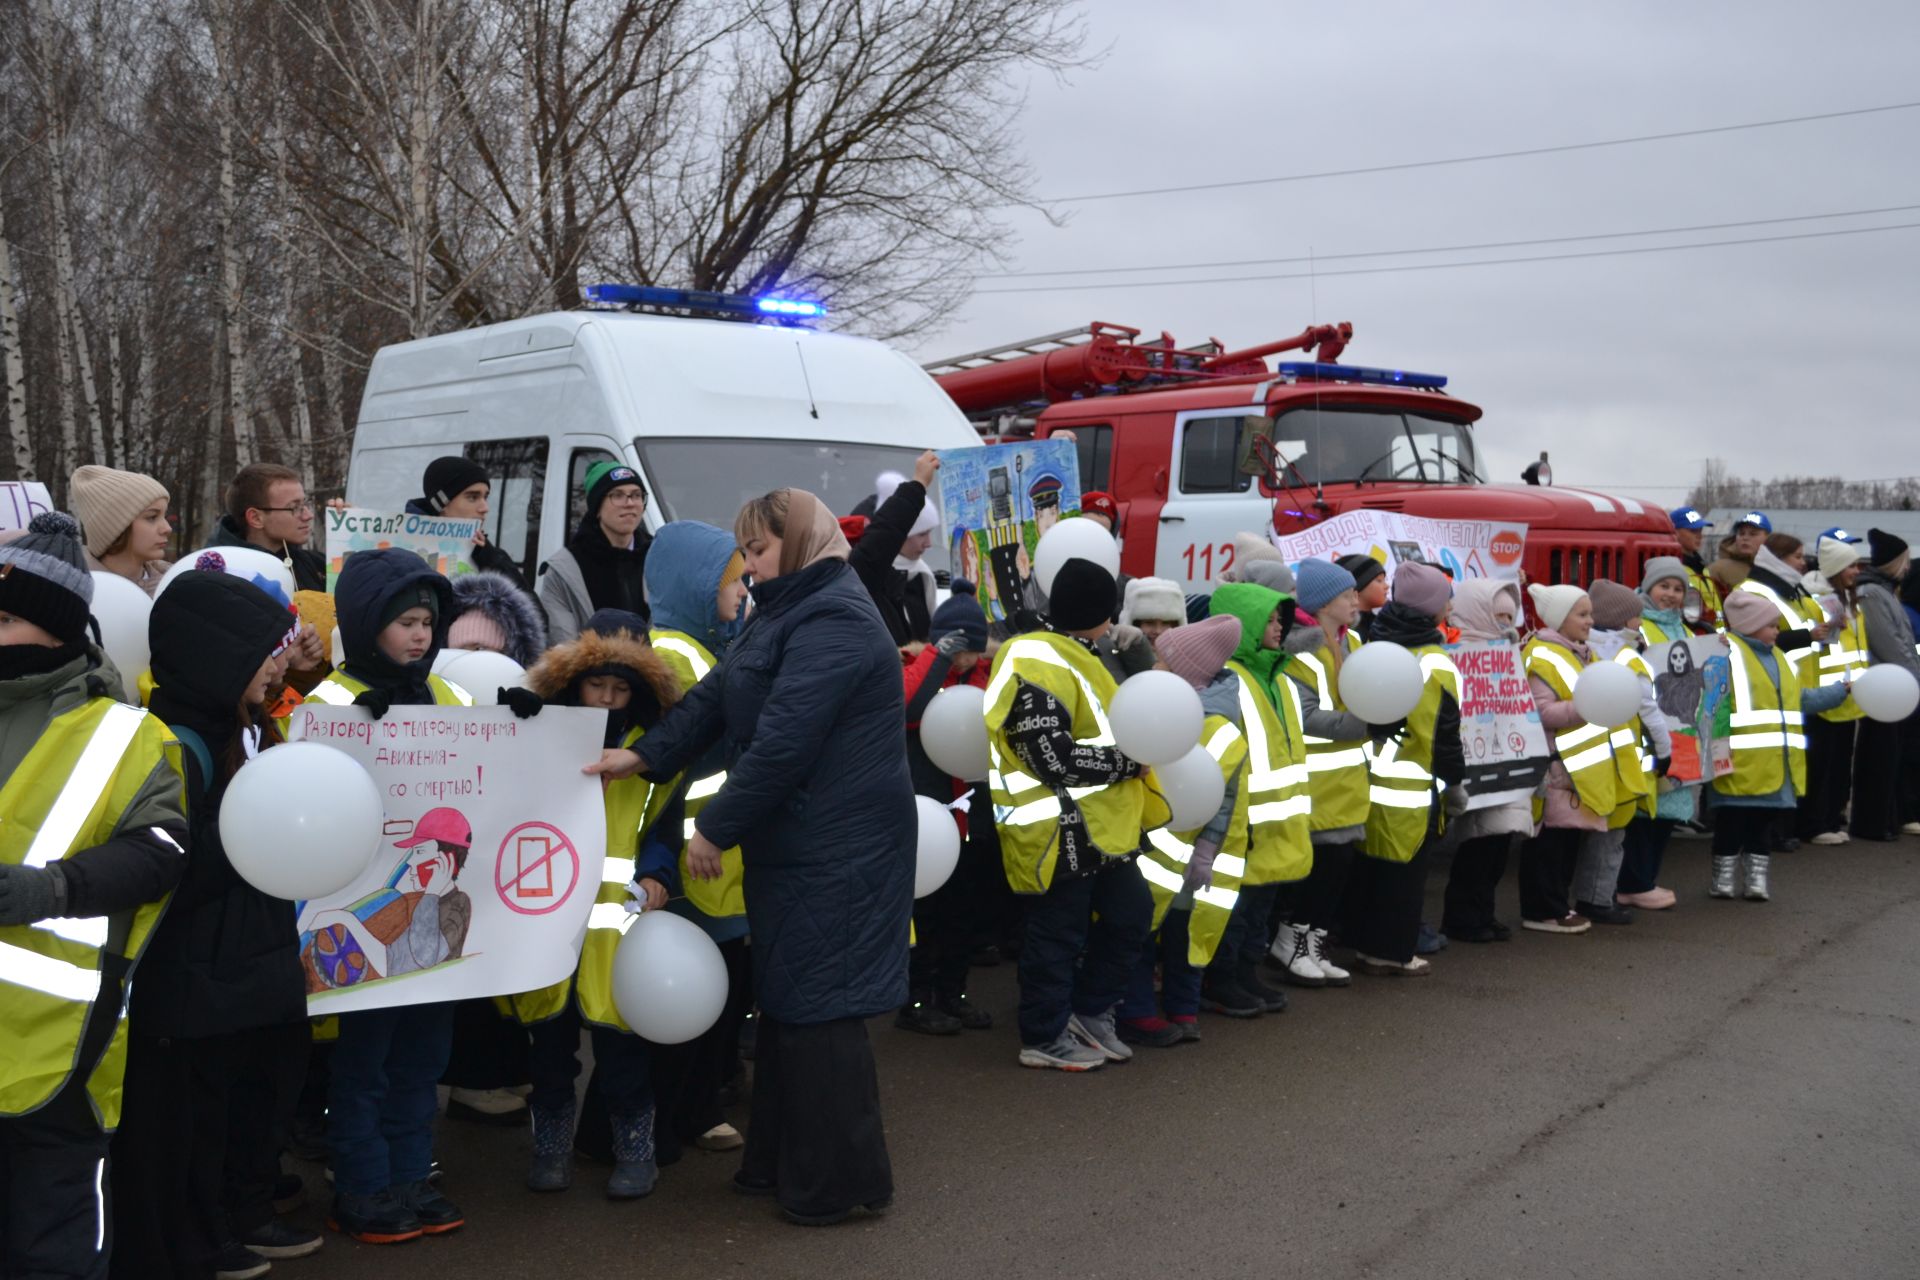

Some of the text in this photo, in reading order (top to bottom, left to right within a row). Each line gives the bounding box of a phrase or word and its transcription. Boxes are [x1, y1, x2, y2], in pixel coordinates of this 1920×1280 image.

[328, 510, 404, 534] Устал?
[1492, 541, 1520, 554] STOP
[1183, 543, 1235, 581] 112
[1451, 650, 1516, 675] ИЖЕНИЕ
[1016, 714, 1060, 733] adidas
[1075, 758, 1113, 772] adidas
[1065, 830, 1079, 871] adidas
